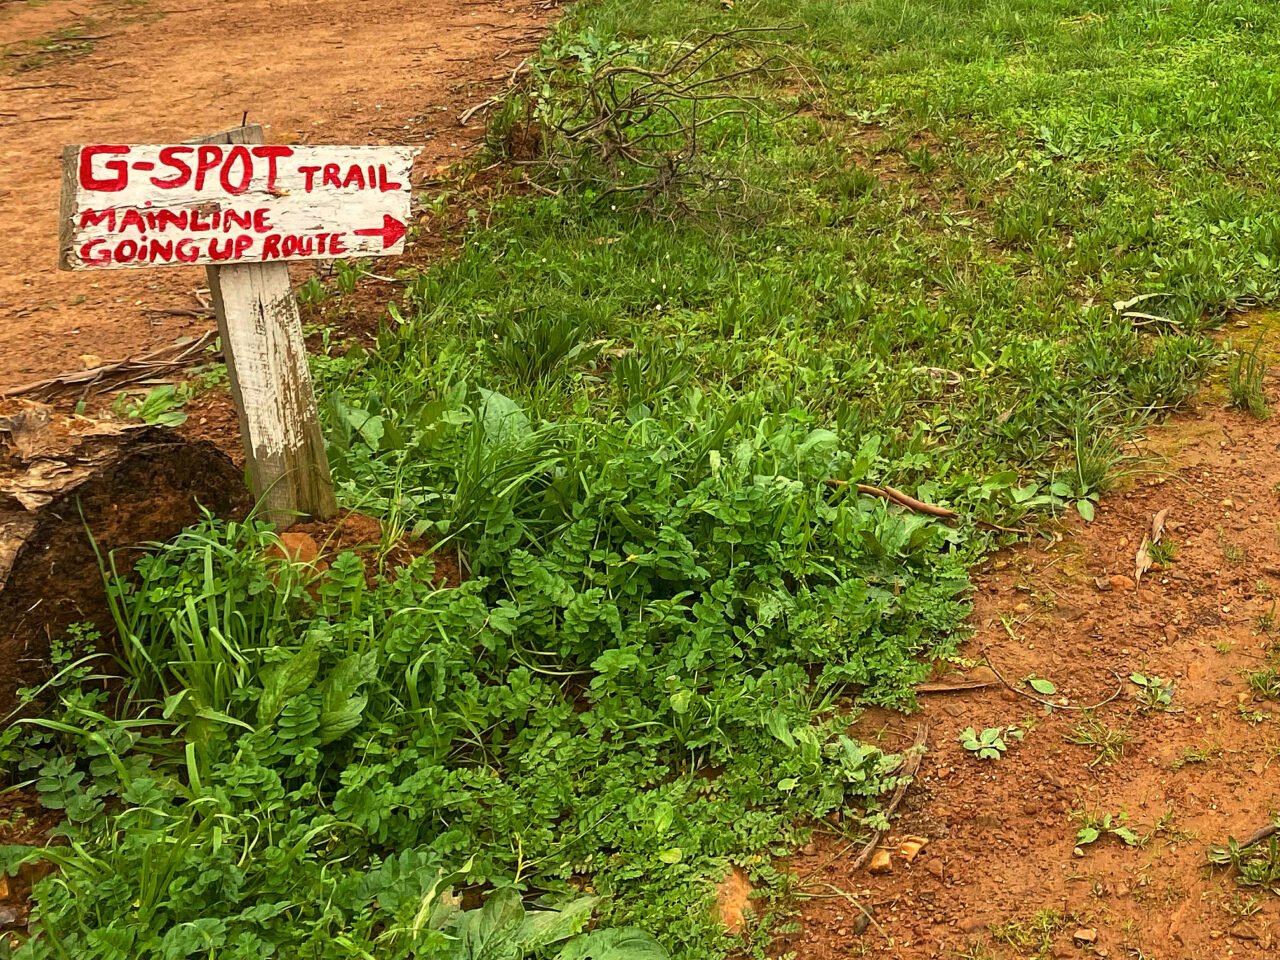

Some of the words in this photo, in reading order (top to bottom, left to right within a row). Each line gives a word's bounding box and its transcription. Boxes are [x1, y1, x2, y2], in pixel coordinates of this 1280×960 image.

[78, 143, 294, 196] G-SPOT
[297, 163, 402, 193] TRAIL
[208, 234, 255, 262] UP
[261, 231, 348, 261] ROUTE
